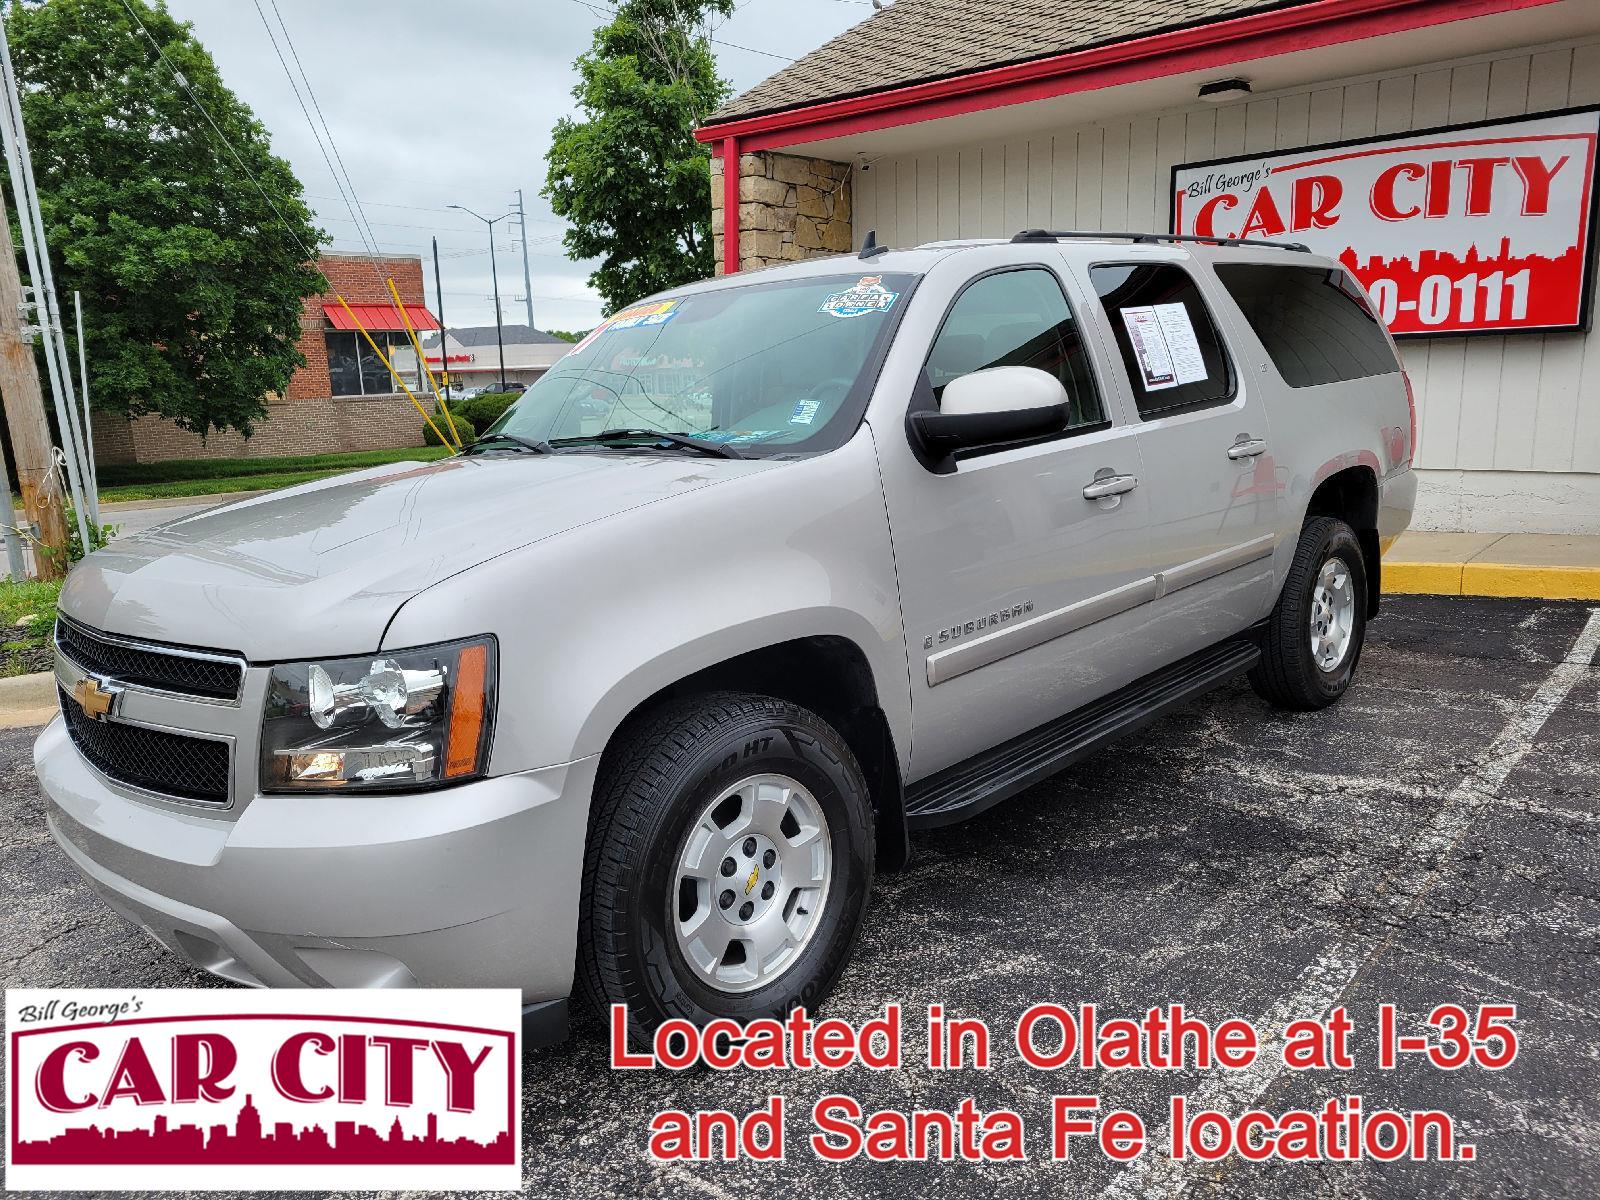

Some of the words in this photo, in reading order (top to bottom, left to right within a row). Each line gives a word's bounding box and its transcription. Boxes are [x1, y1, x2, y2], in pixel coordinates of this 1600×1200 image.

[1188, 173, 1214, 198] Bill
[1215, 162, 1271, 193] George's
[1192, 175, 1344, 245] CAR
[1369, 155, 1570, 223] CITY
[938, 599, 1034, 644] SUBURBAN
[743, 736, 774, 759] HT
